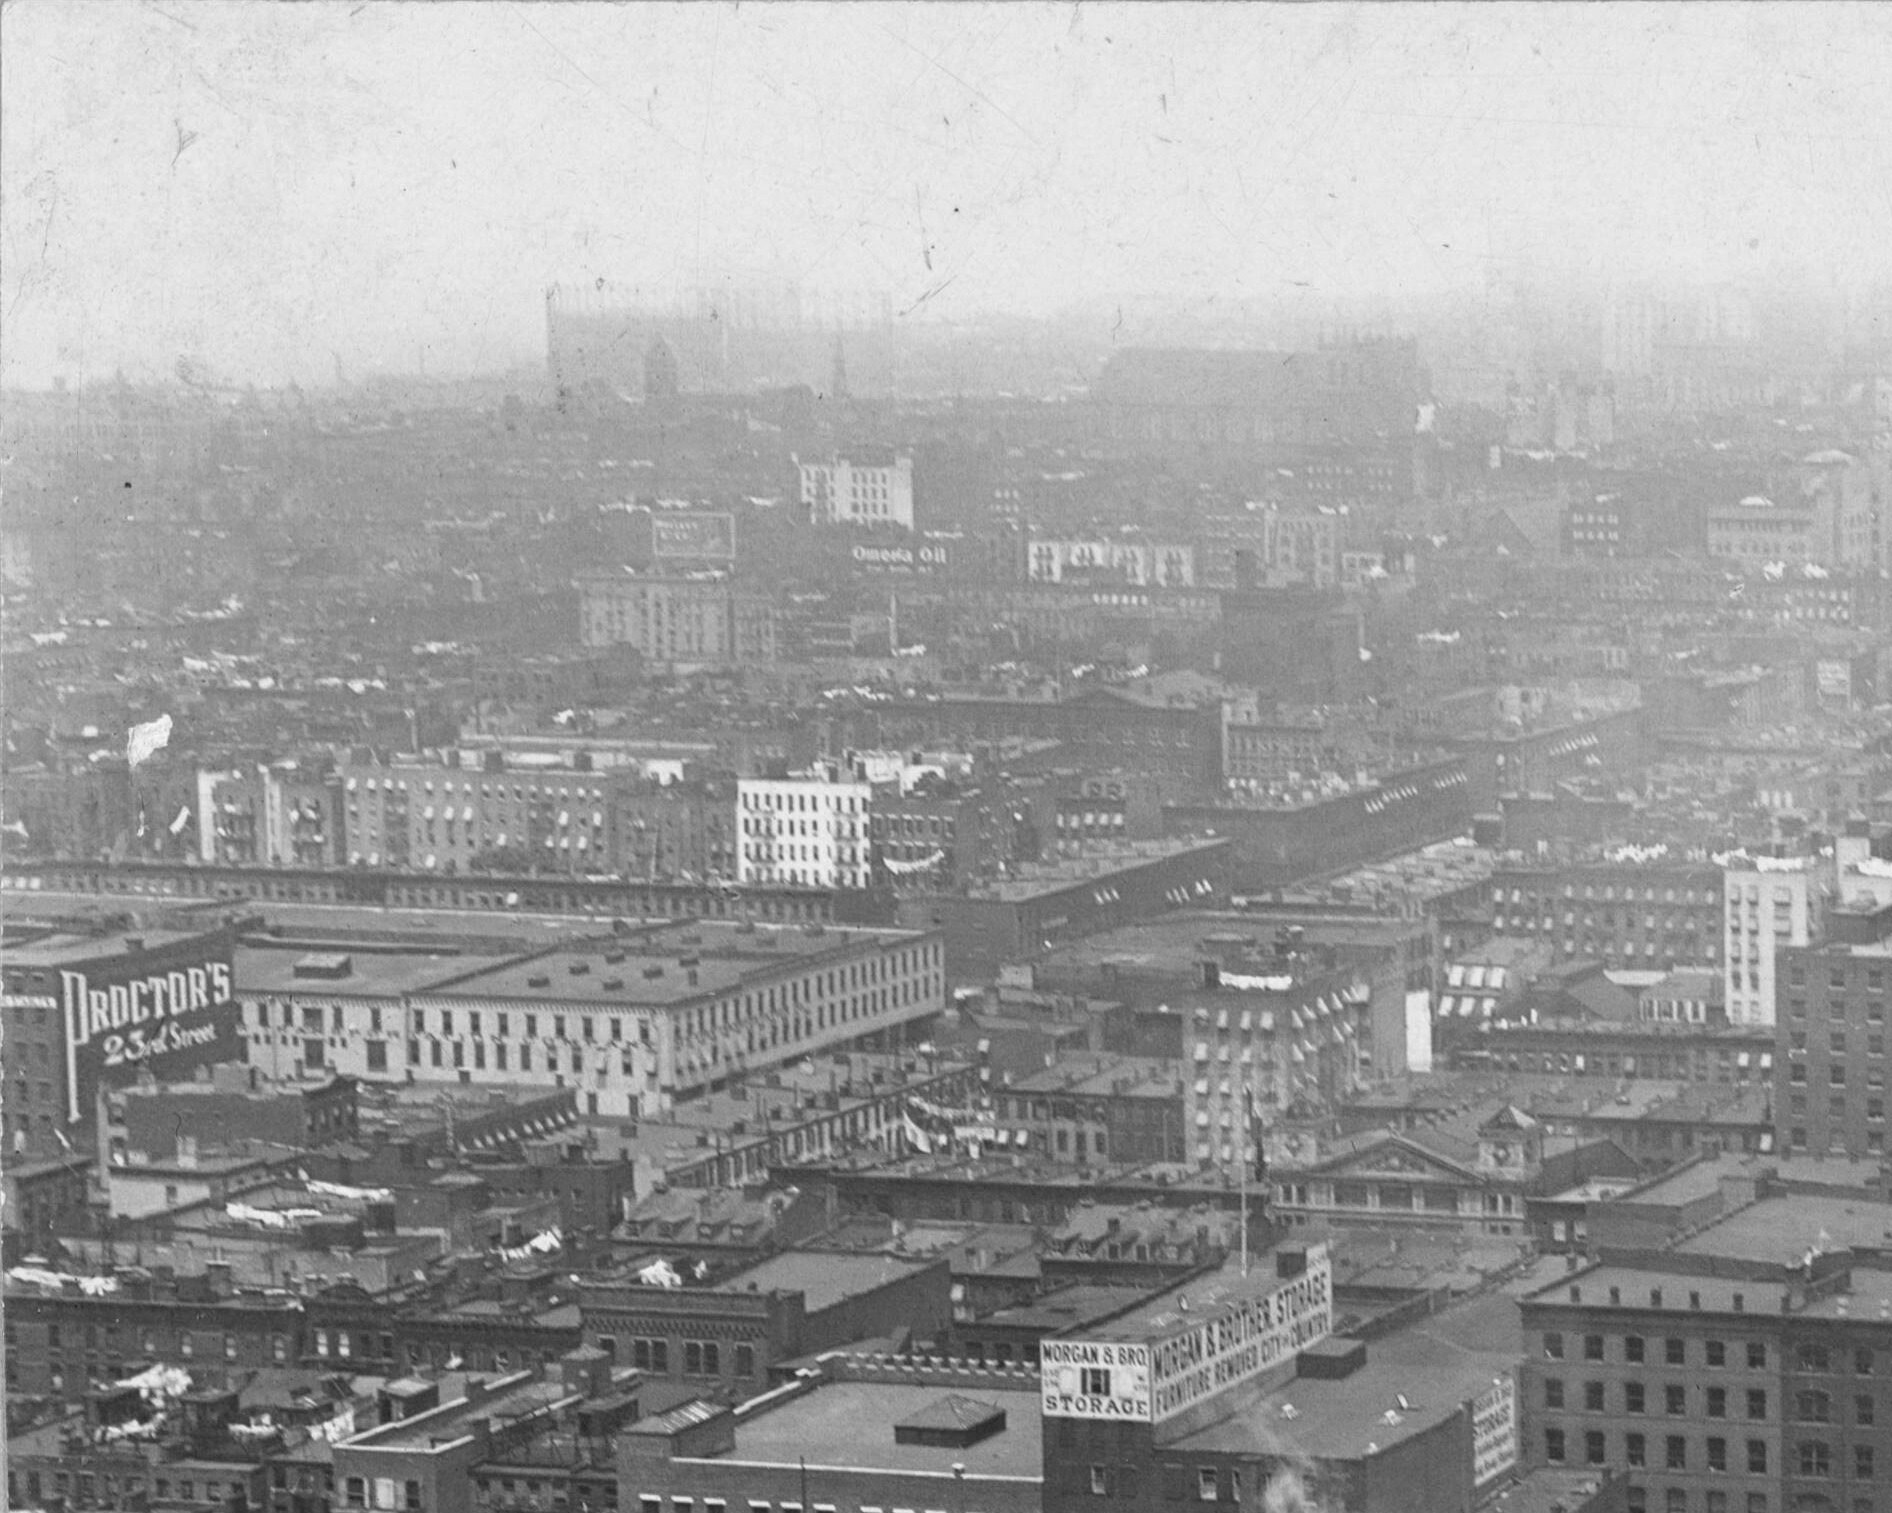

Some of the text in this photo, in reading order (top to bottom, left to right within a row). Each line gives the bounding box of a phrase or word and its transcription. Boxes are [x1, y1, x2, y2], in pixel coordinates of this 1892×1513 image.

[59, 962, 231, 1124] PROCTOR'S
[1042, 1344, 1100, 1364] MORGAN
[1103, 1347, 1114, 1364] &
[1046, 1396, 1148, 1416] STORAGE
